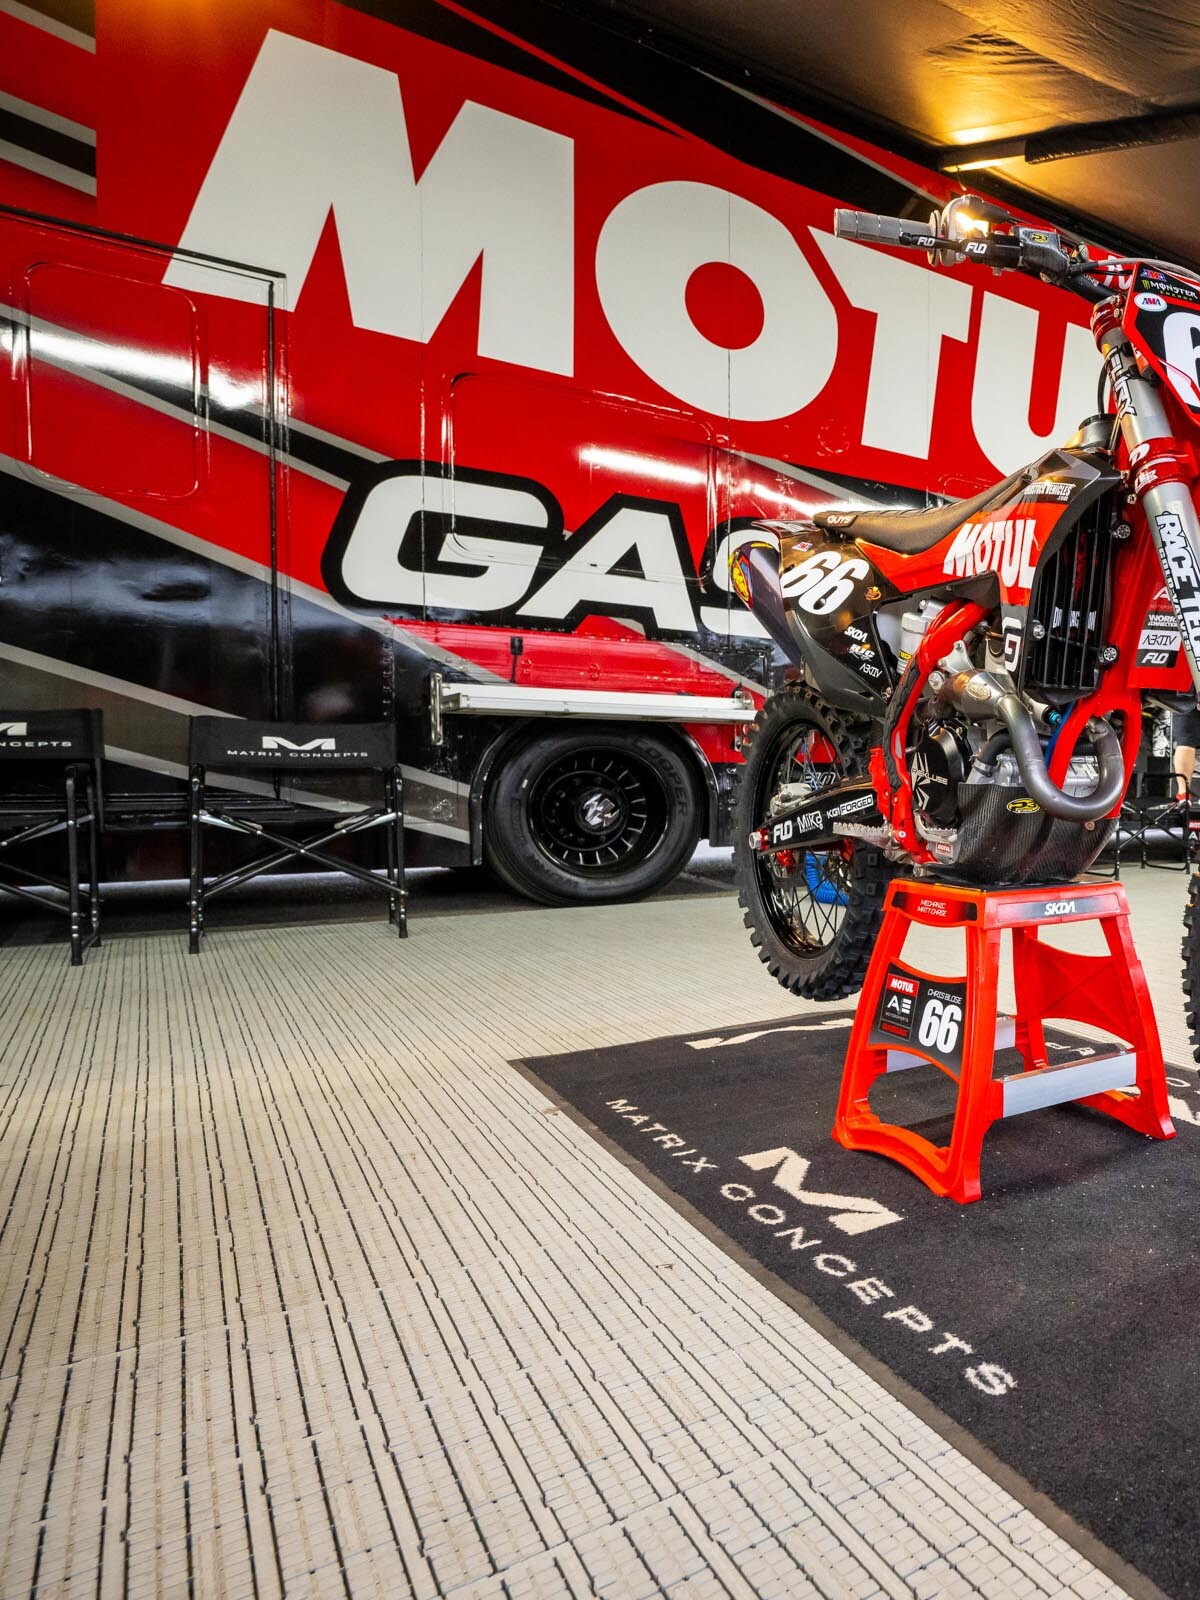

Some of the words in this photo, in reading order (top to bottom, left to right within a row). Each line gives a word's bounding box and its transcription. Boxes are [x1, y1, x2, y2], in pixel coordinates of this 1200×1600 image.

[917, 236, 936, 247] FLO
[965, 242, 988, 254] FLO
[162, 28, 1110, 480] MOTU
[1150, 280, 1198, 299] MONSTER
[1142, 297, 1162, 306] AMA
[942, 520, 1038, 590] MOTUL
[1155, 512, 1199, 590] RACE
[780, 551, 870, 615] 66
[1141, 652, 1170, 664] FLO
[0, 741, 72, 749] NCEPTS
[227, 750, 282, 758] MATRIX
[912, 767, 949, 786] REKLUSE
[840, 796, 874, 816] FORGED
[773, 820, 793, 844] FLO
[1044, 901, 1076, 916] SKDA
[890, 978, 914, 993] MOTUL
[918, 999, 962, 1054] 66
[605, 1098, 719, 1174] MATRIX
[719, 1182, 1018, 1396] CONCEPTS
